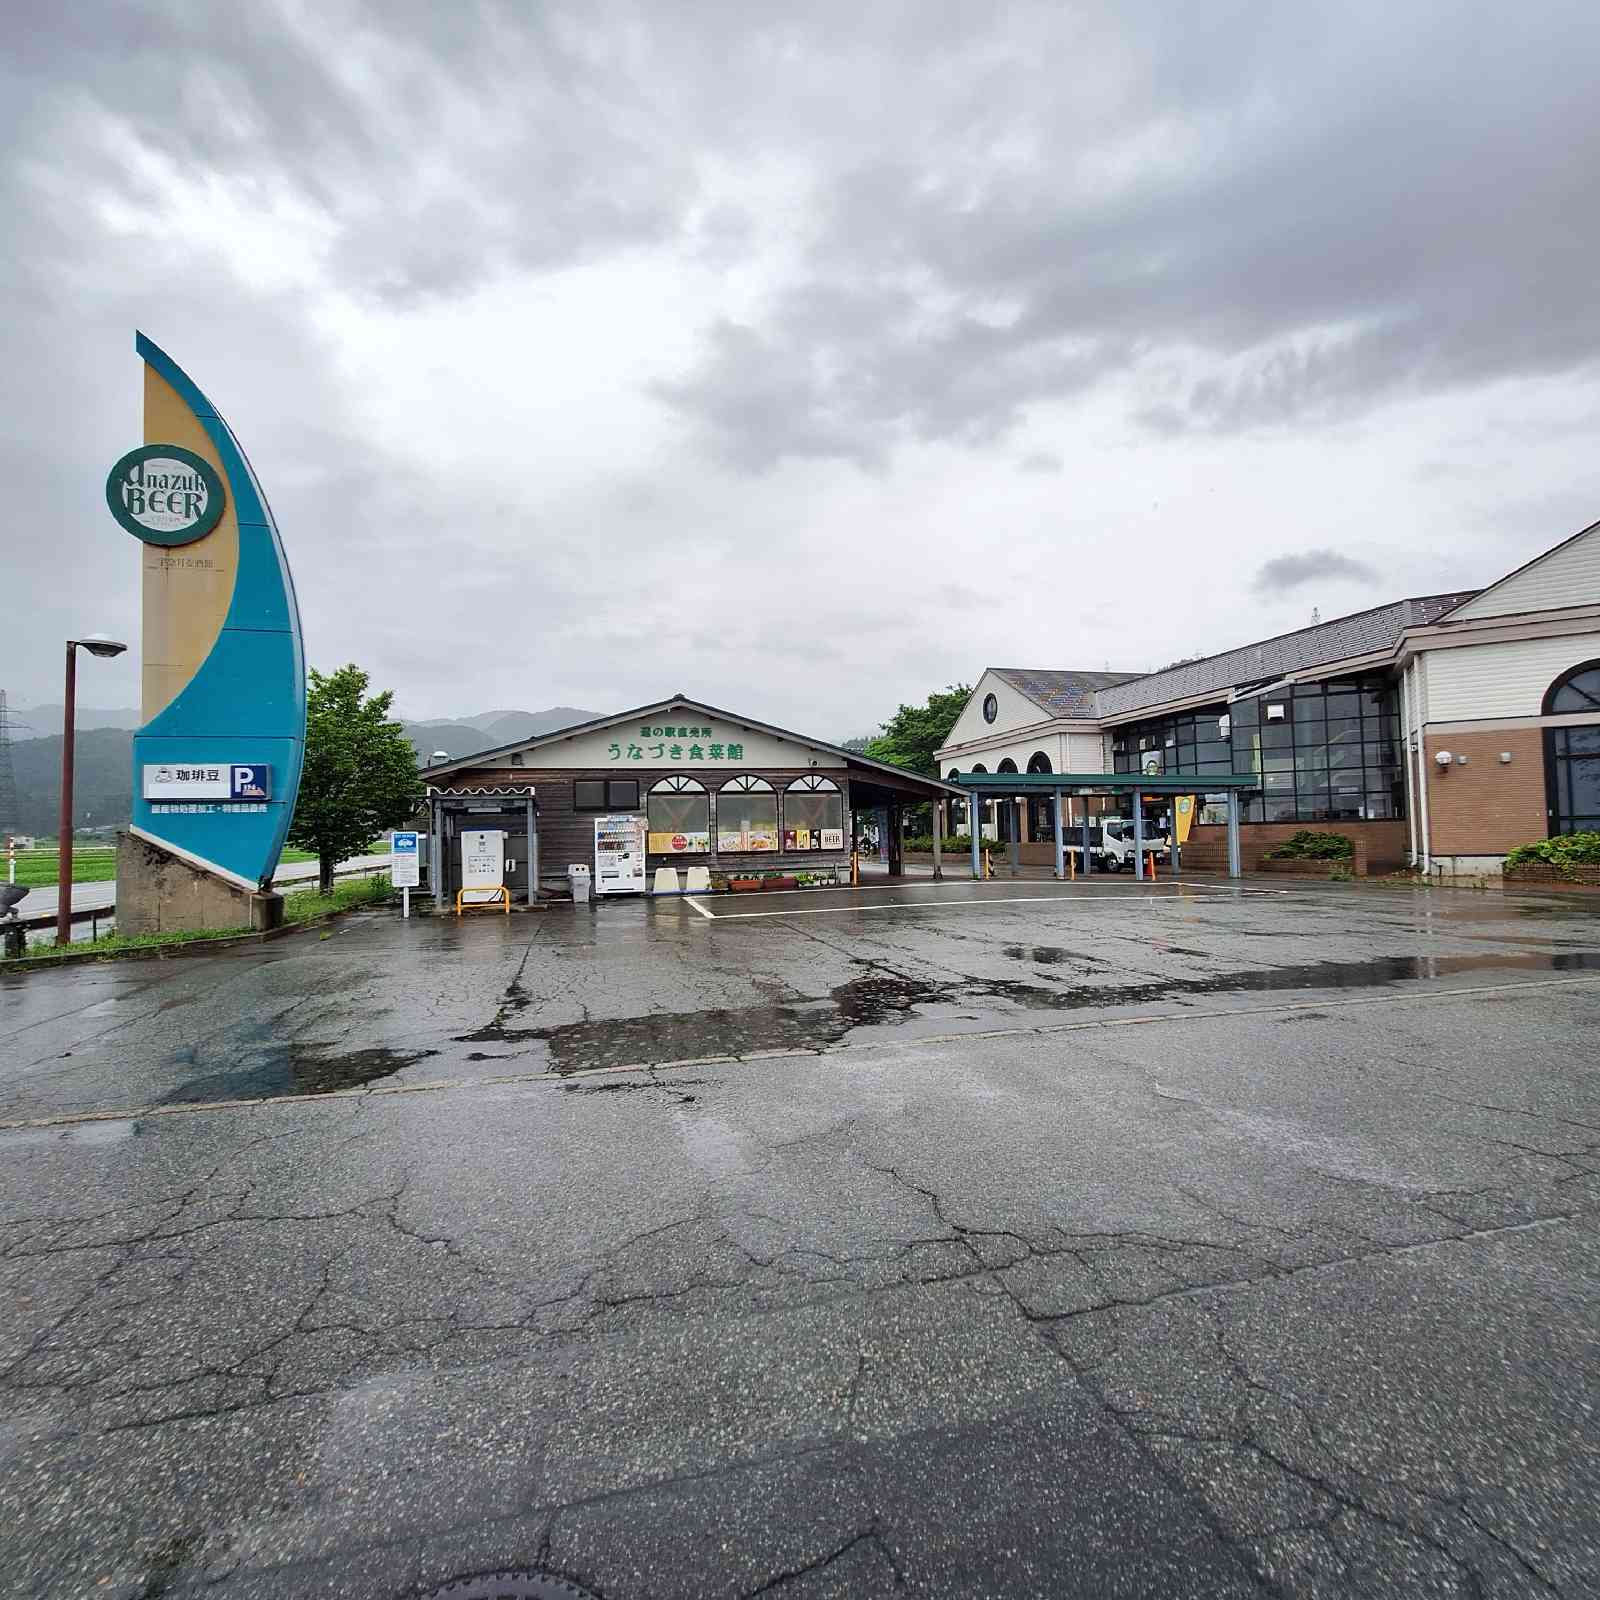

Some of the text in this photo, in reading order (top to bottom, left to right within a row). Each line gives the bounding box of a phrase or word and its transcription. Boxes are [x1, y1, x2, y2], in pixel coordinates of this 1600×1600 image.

[126, 487, 204, 519] BEER
[608, 743, 744, 761] うなづき食菜館
[175, 769, 220, 782] 珈琲豆
[234, 767, 254, 793] P
